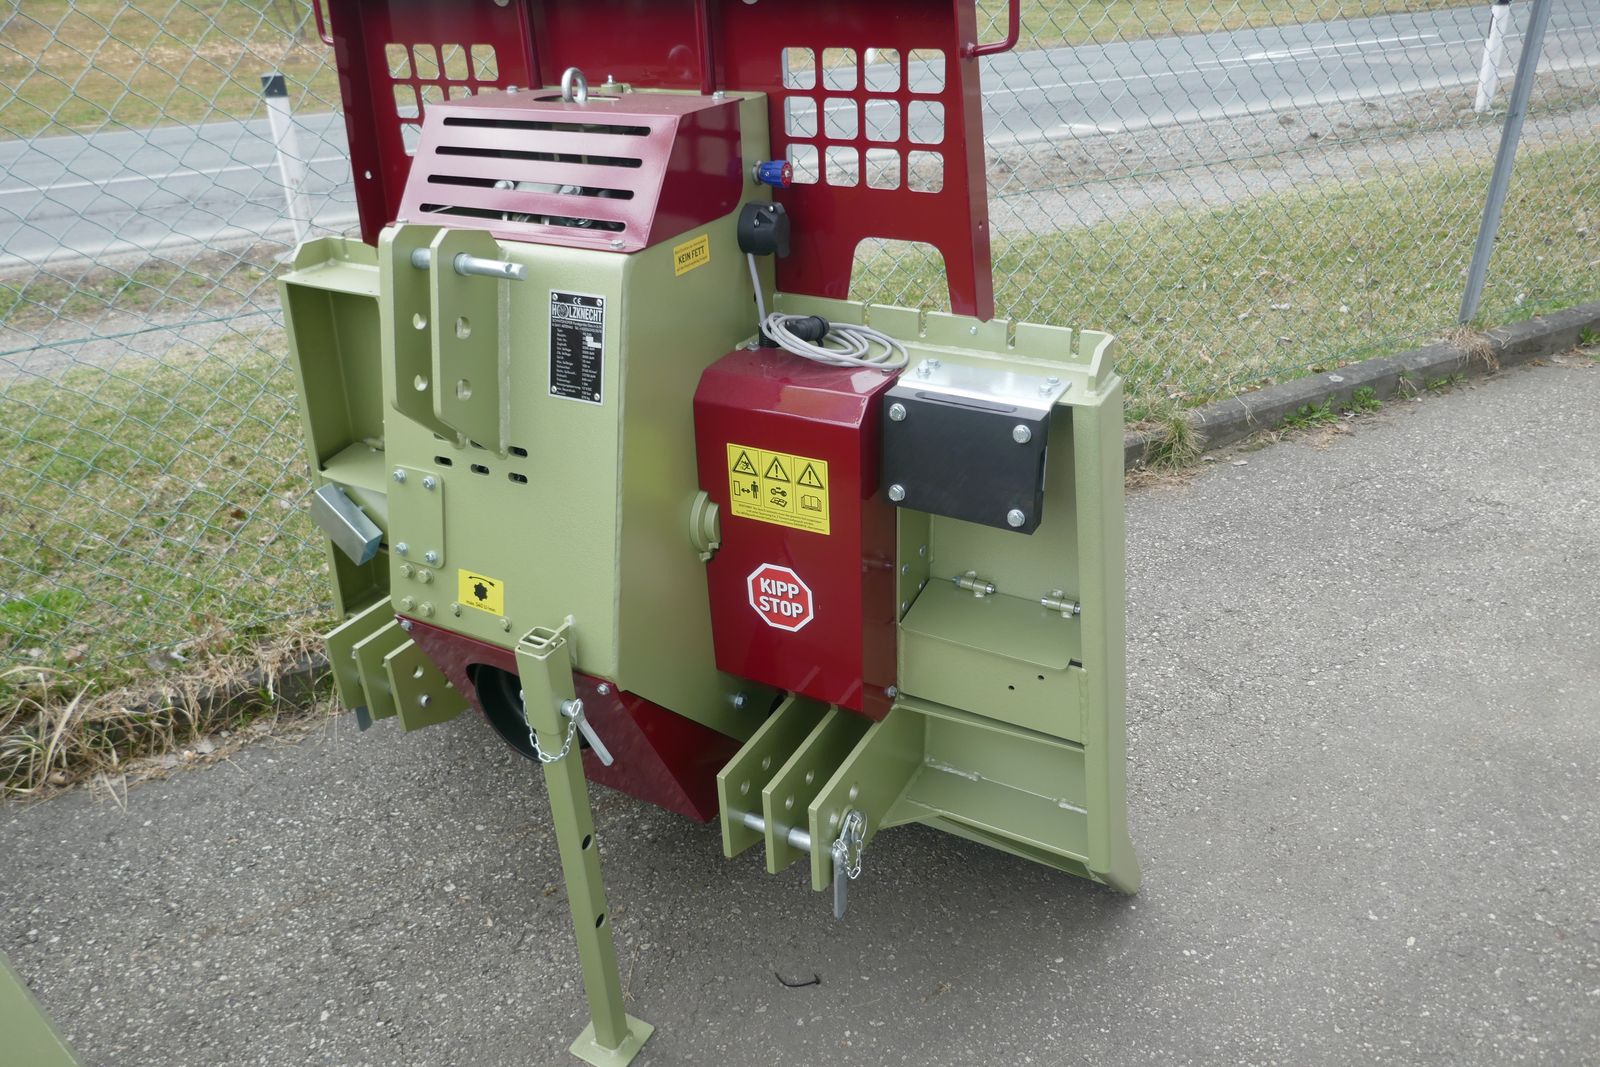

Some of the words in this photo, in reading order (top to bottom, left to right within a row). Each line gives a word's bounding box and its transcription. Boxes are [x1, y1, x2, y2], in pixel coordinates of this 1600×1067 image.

[678, 251, 691, 265] KEIN
[691, 245, 705, 259] FETT
[551, 303, 602, 321] HOLZKNECHT
[760, 577, 800, 599] KIPP
[759, 595, 804, 618] STOP
